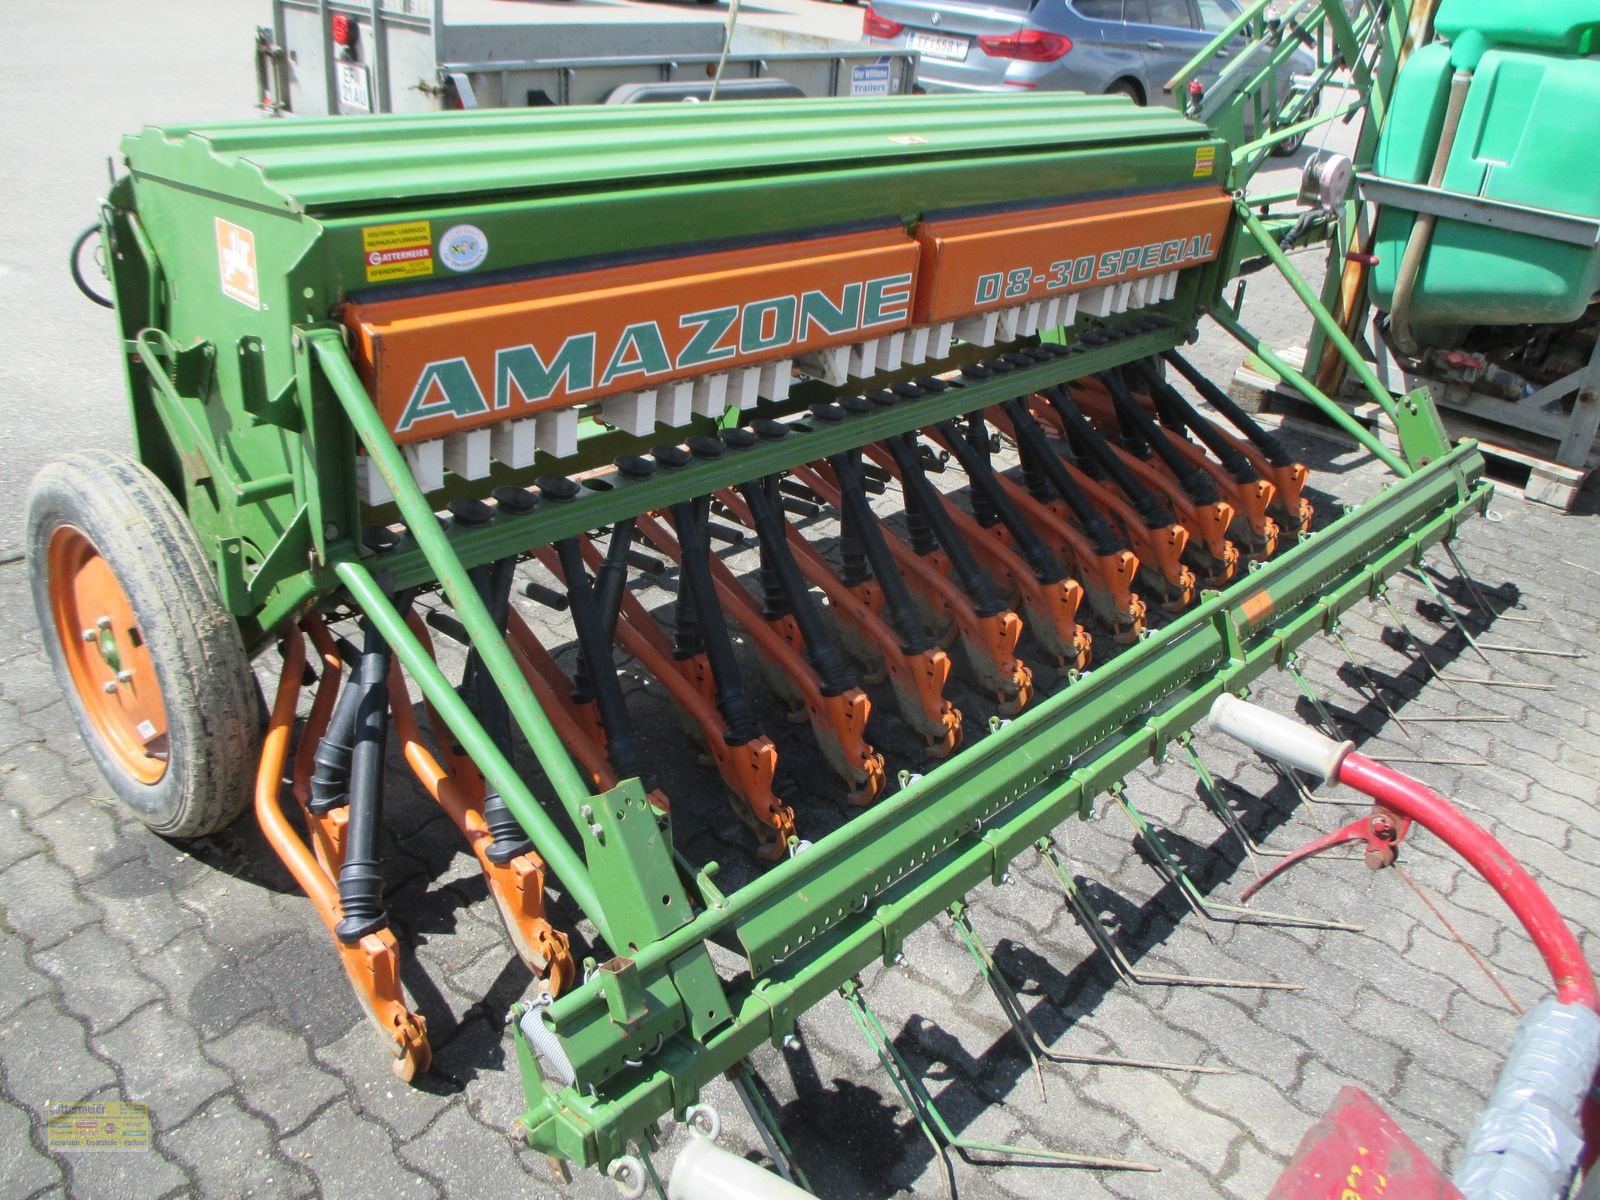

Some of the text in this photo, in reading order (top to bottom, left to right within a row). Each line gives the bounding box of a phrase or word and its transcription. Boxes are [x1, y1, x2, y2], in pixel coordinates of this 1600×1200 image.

[854, 82, 886, 93] Trailers
[1097, 233, 1214, 280] SPECIAL
[395, 273, 913, 433] AMAZONE
